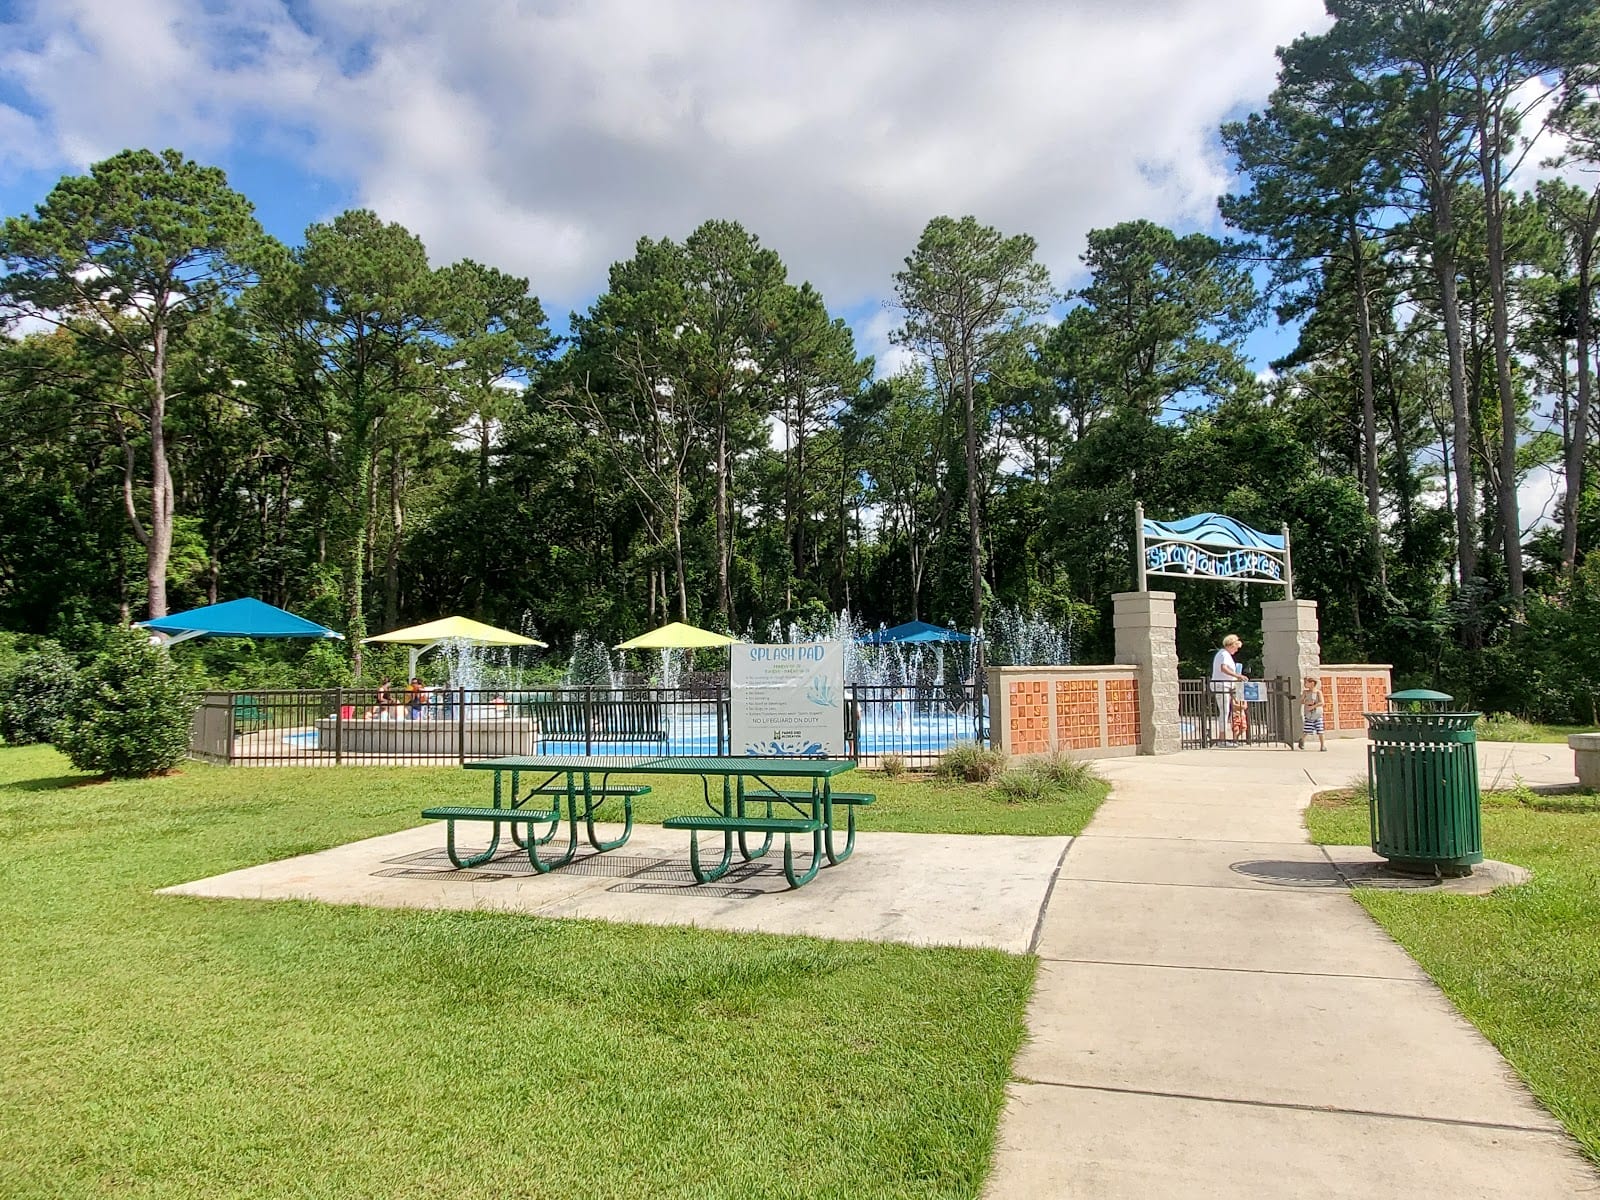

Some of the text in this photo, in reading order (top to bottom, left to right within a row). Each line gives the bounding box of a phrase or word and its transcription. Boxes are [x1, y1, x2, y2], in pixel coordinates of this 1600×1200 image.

[1148, 545, 1281, 579] Sprayground Express
[750, 645, 825, 661] SPLASH PAD
